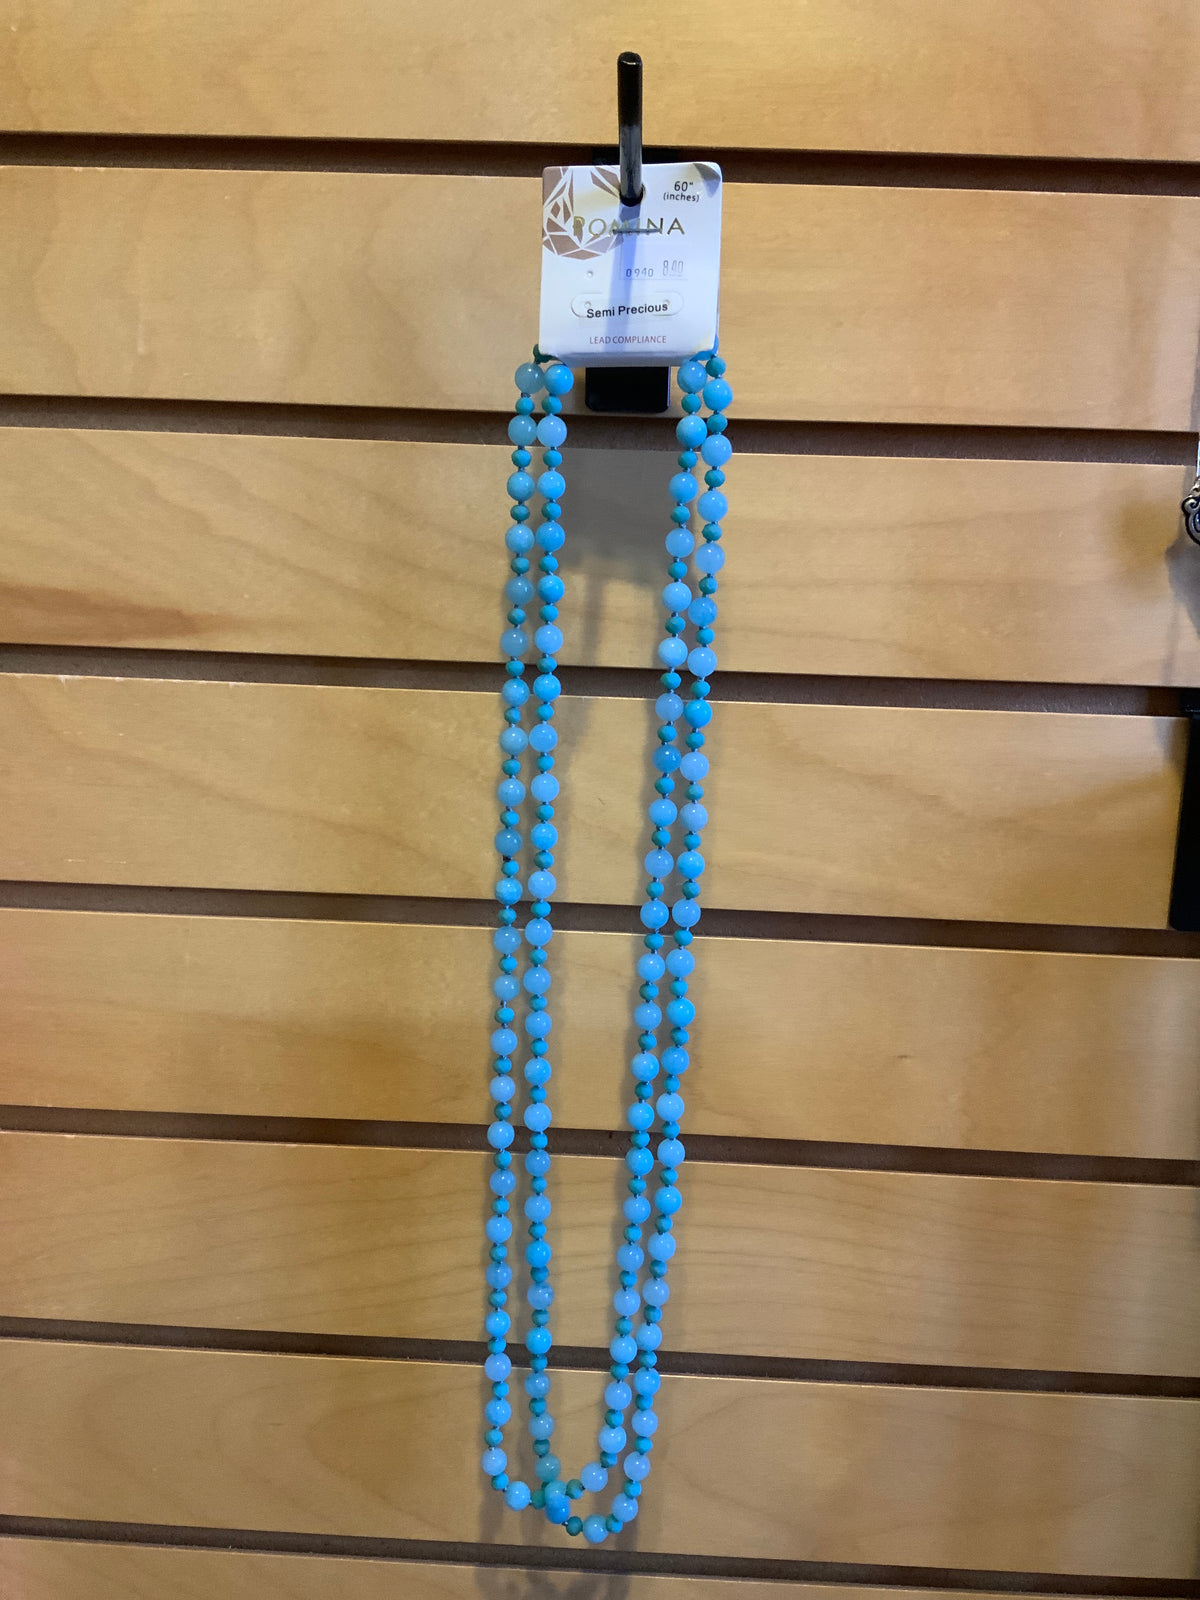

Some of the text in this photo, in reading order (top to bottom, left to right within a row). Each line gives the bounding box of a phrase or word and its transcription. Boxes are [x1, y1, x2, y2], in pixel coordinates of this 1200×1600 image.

[663, 192, 700, 203] (inches)
[586, 303, 669, 319] Semi Precious
[589, 335, 667, 345] LEAD COMPLIANCE
